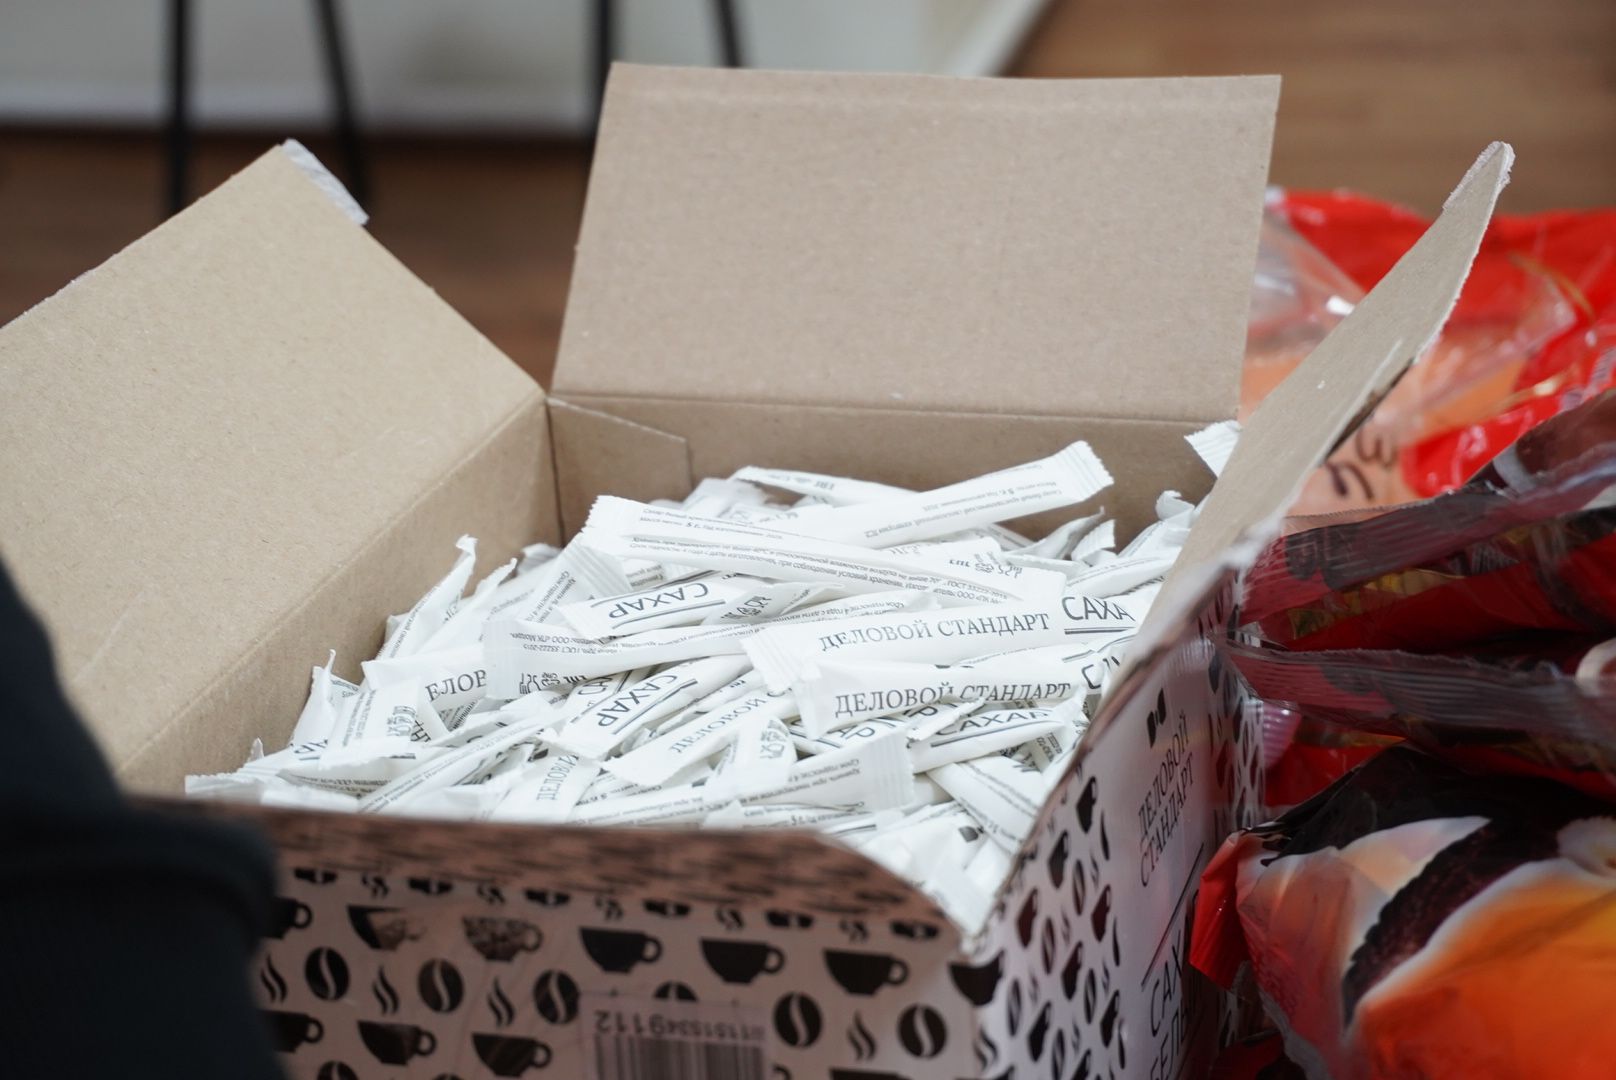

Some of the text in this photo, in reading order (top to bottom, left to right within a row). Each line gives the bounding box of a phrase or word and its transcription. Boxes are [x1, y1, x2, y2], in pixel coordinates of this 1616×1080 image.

[608, 582, 710, 620] САХАР
[1061, 596, 1136, 622] САХА
[818, 619, 933, 652] ДЕЛОВОЙ
[937, 612, 1050, 637] СТАНДАРТ
[597, 674, 678, 728] САХАР
[834, 681, 954, 719] ДЕЛОВОЙ
[958, 682, 1072, 703] СТАНДАРТ
[1137, 709, 1191, 844] ДЕЛОВОЙ
[1140, 752, 1195, 888] СТАНДАРТ
[1150, 944, 1183, 1038] САХ
